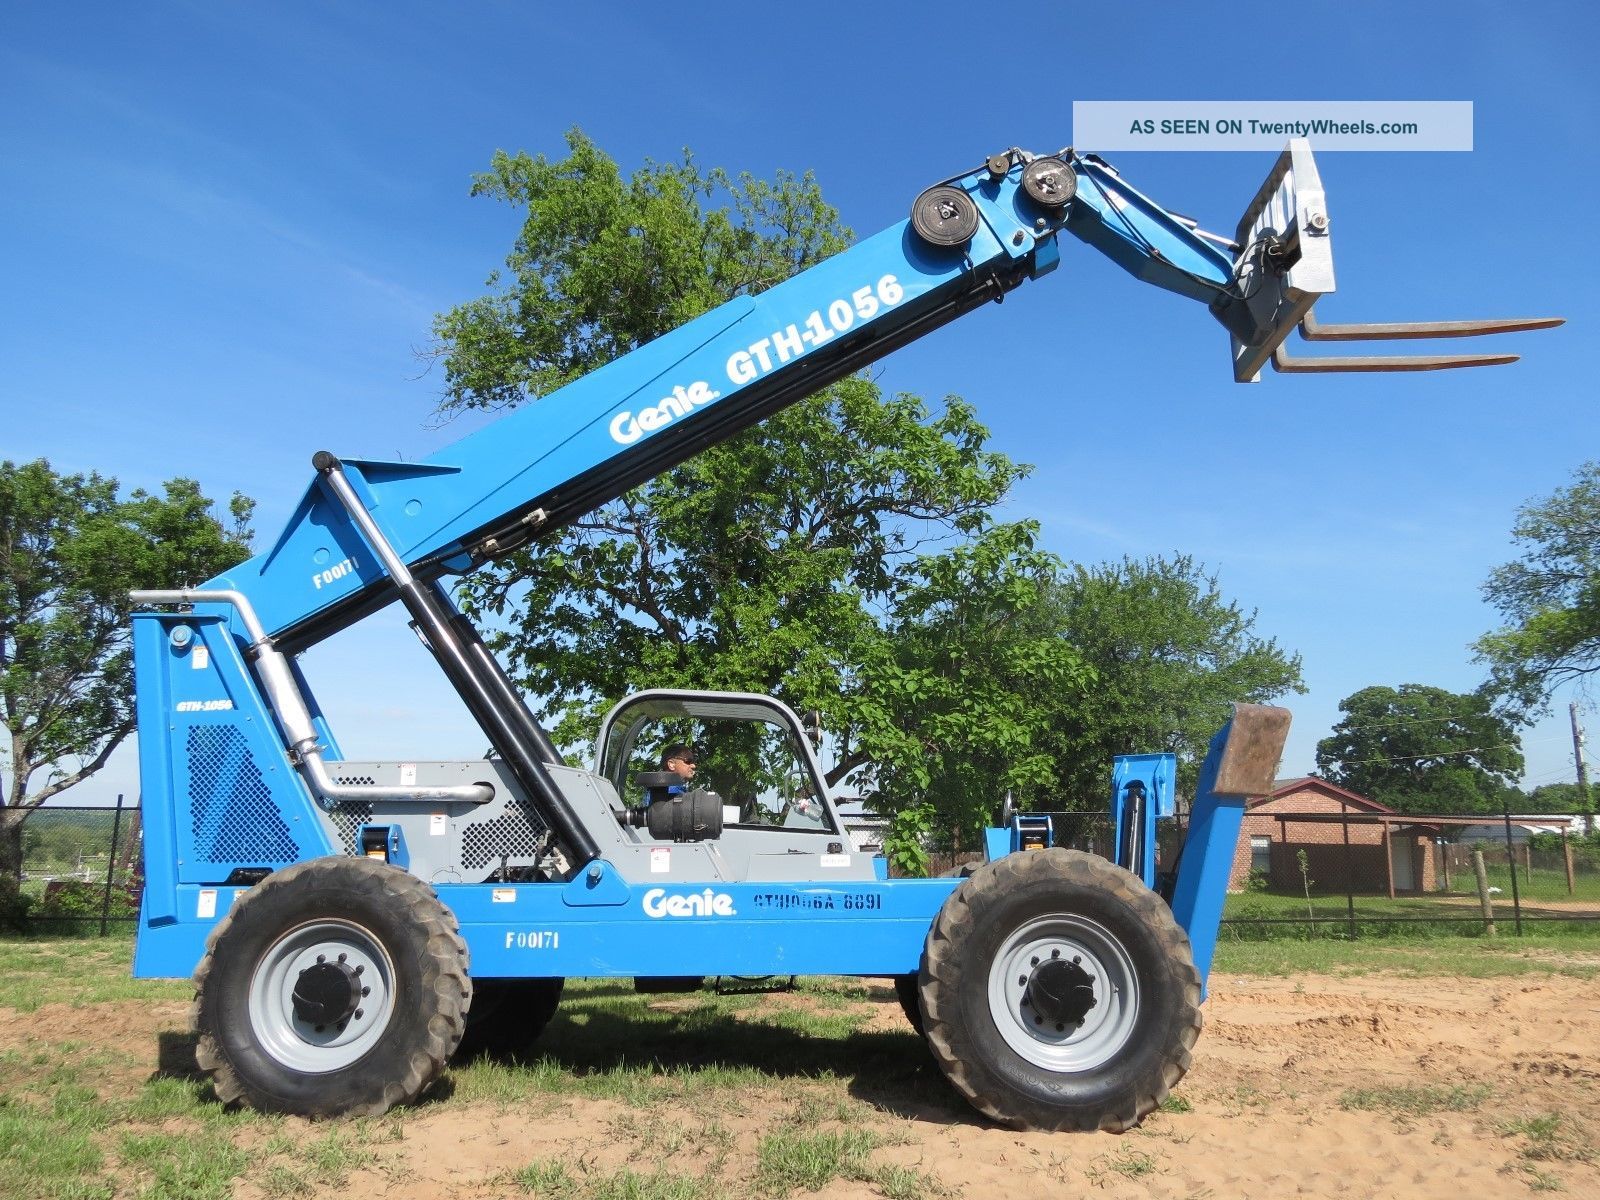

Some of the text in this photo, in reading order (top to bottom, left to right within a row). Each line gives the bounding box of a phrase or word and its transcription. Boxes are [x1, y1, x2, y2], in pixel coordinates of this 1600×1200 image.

[609, 273, 904, 446] Genie GTH-1056
[642, 887, 735, 918] Genie
